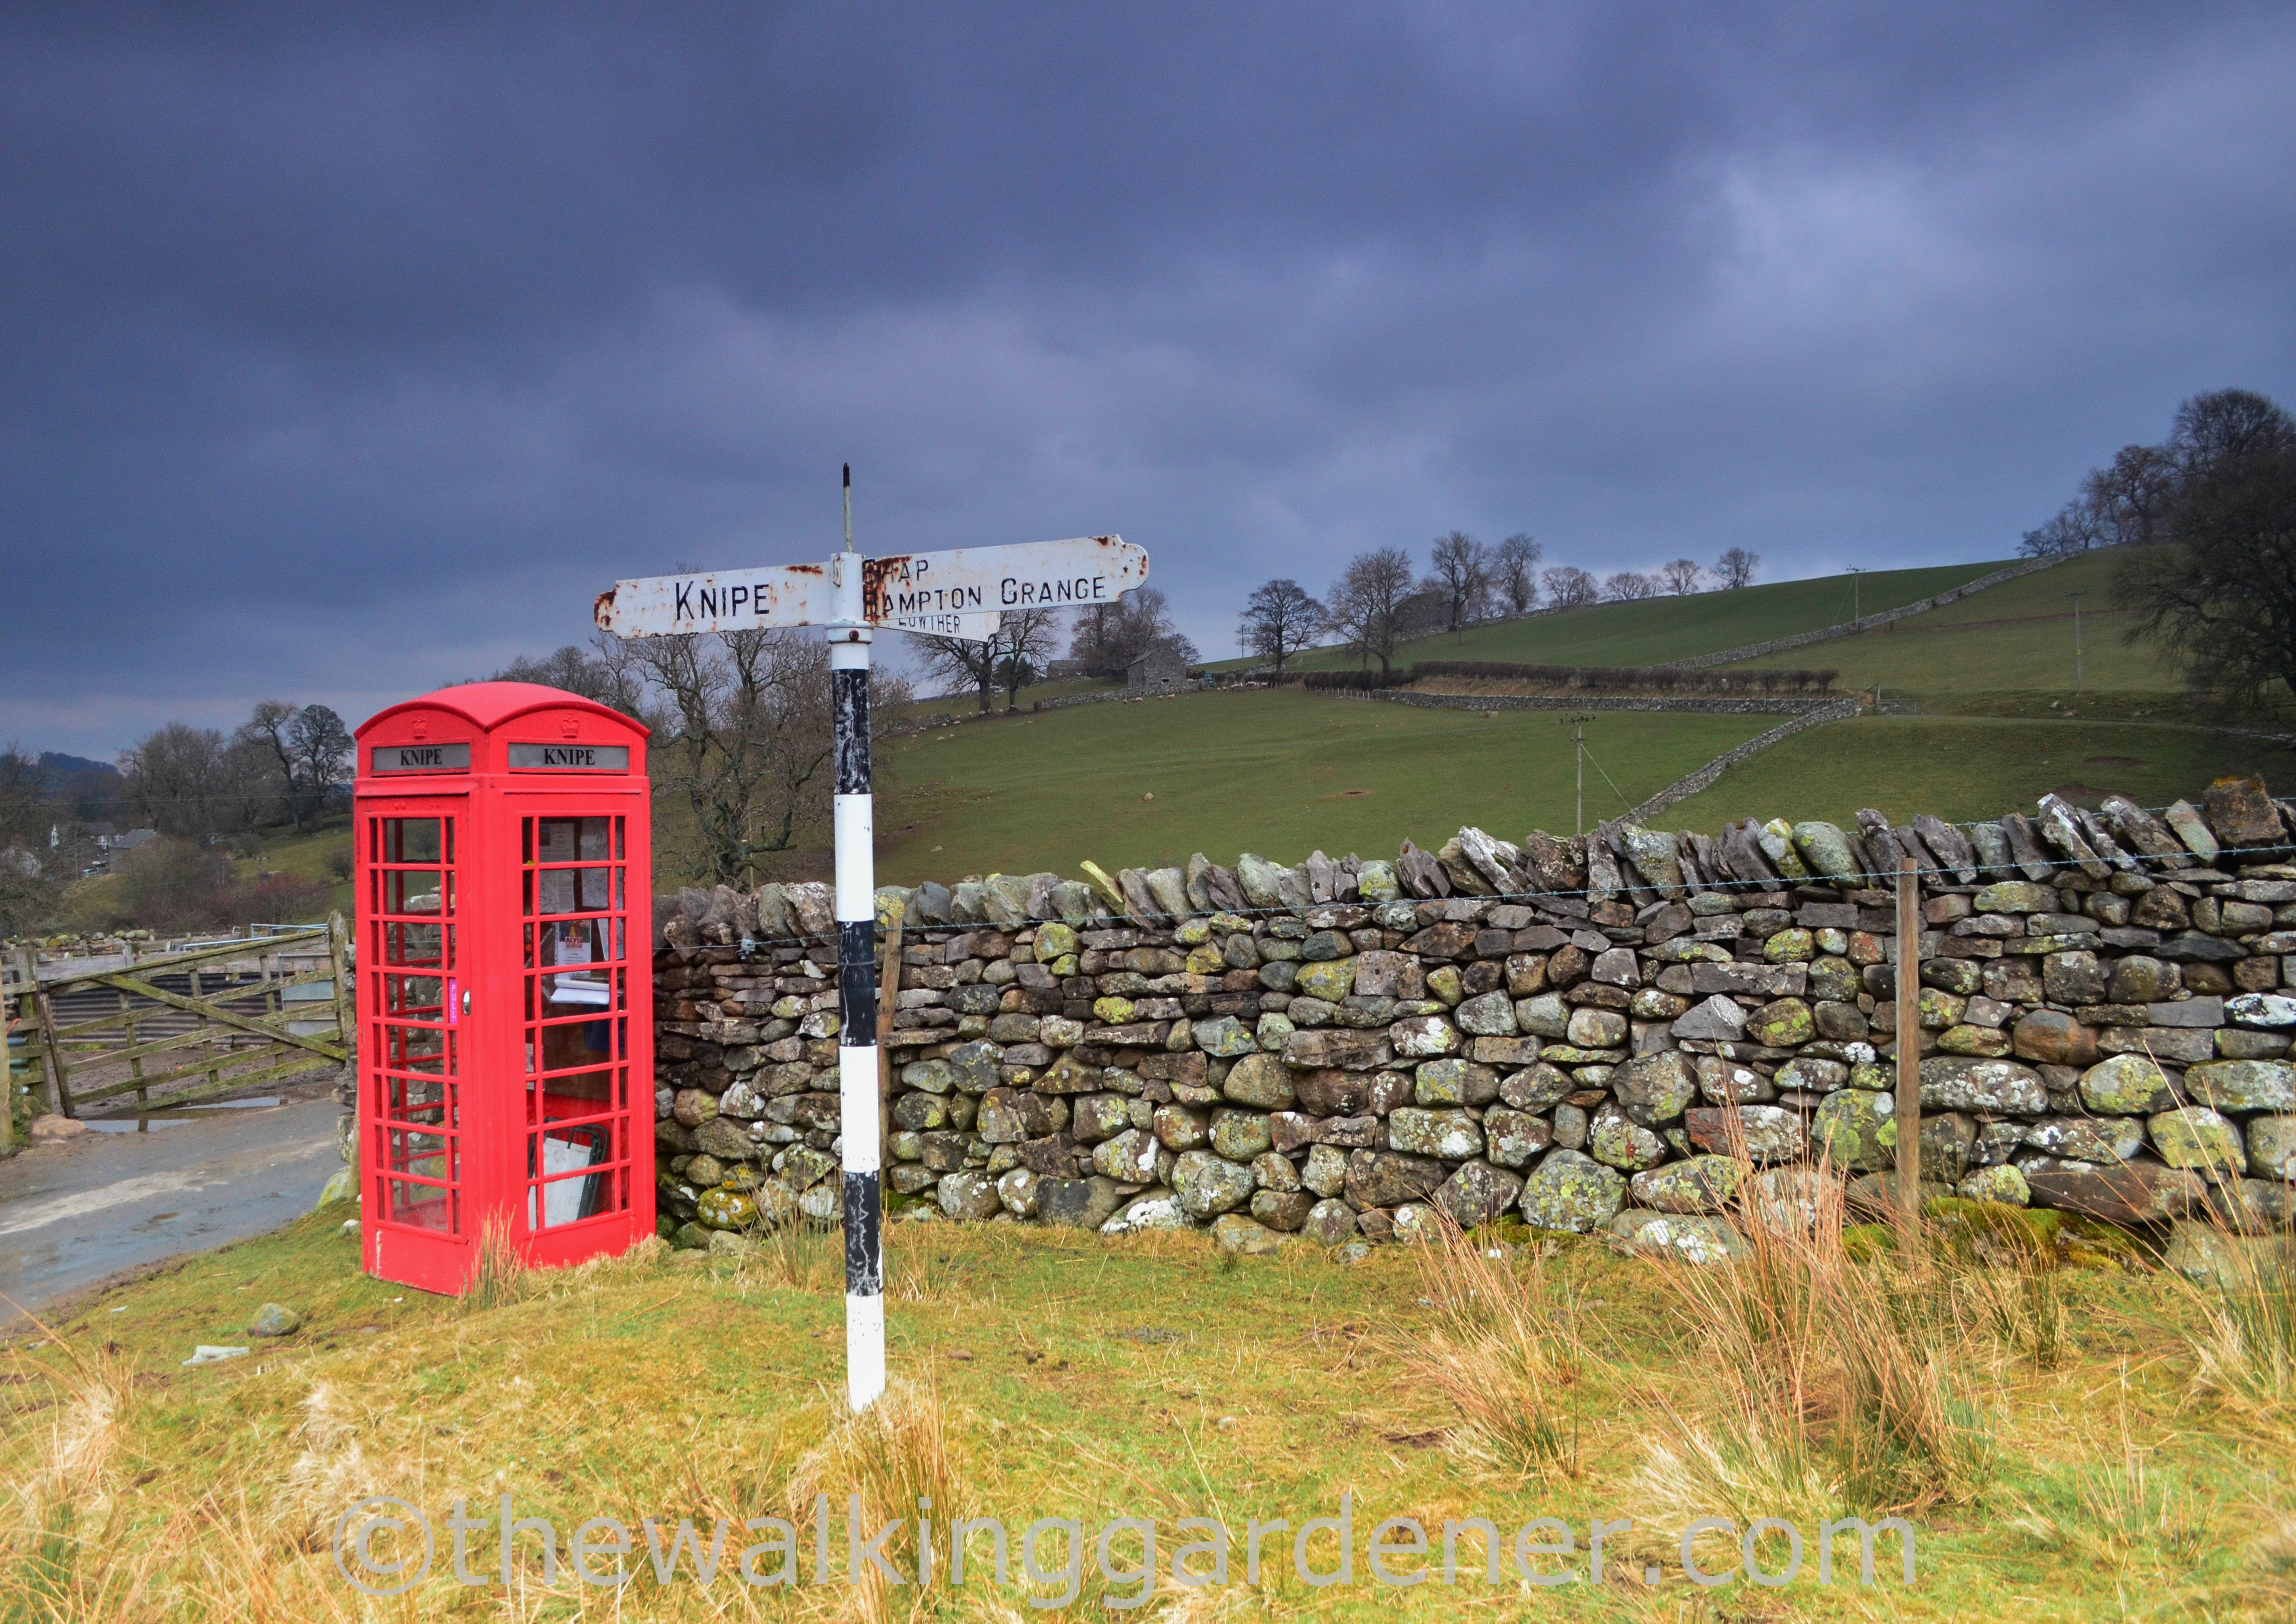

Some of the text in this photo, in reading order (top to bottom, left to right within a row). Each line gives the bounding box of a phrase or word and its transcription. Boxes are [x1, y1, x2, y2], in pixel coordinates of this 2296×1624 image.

[676, 580, 769, 621] KNIPE
[1001, 576, 1106, 605] GRANGE
[400, 749, 442, 765] KNIPE
[544, 749, 595, 765] KNIPE
